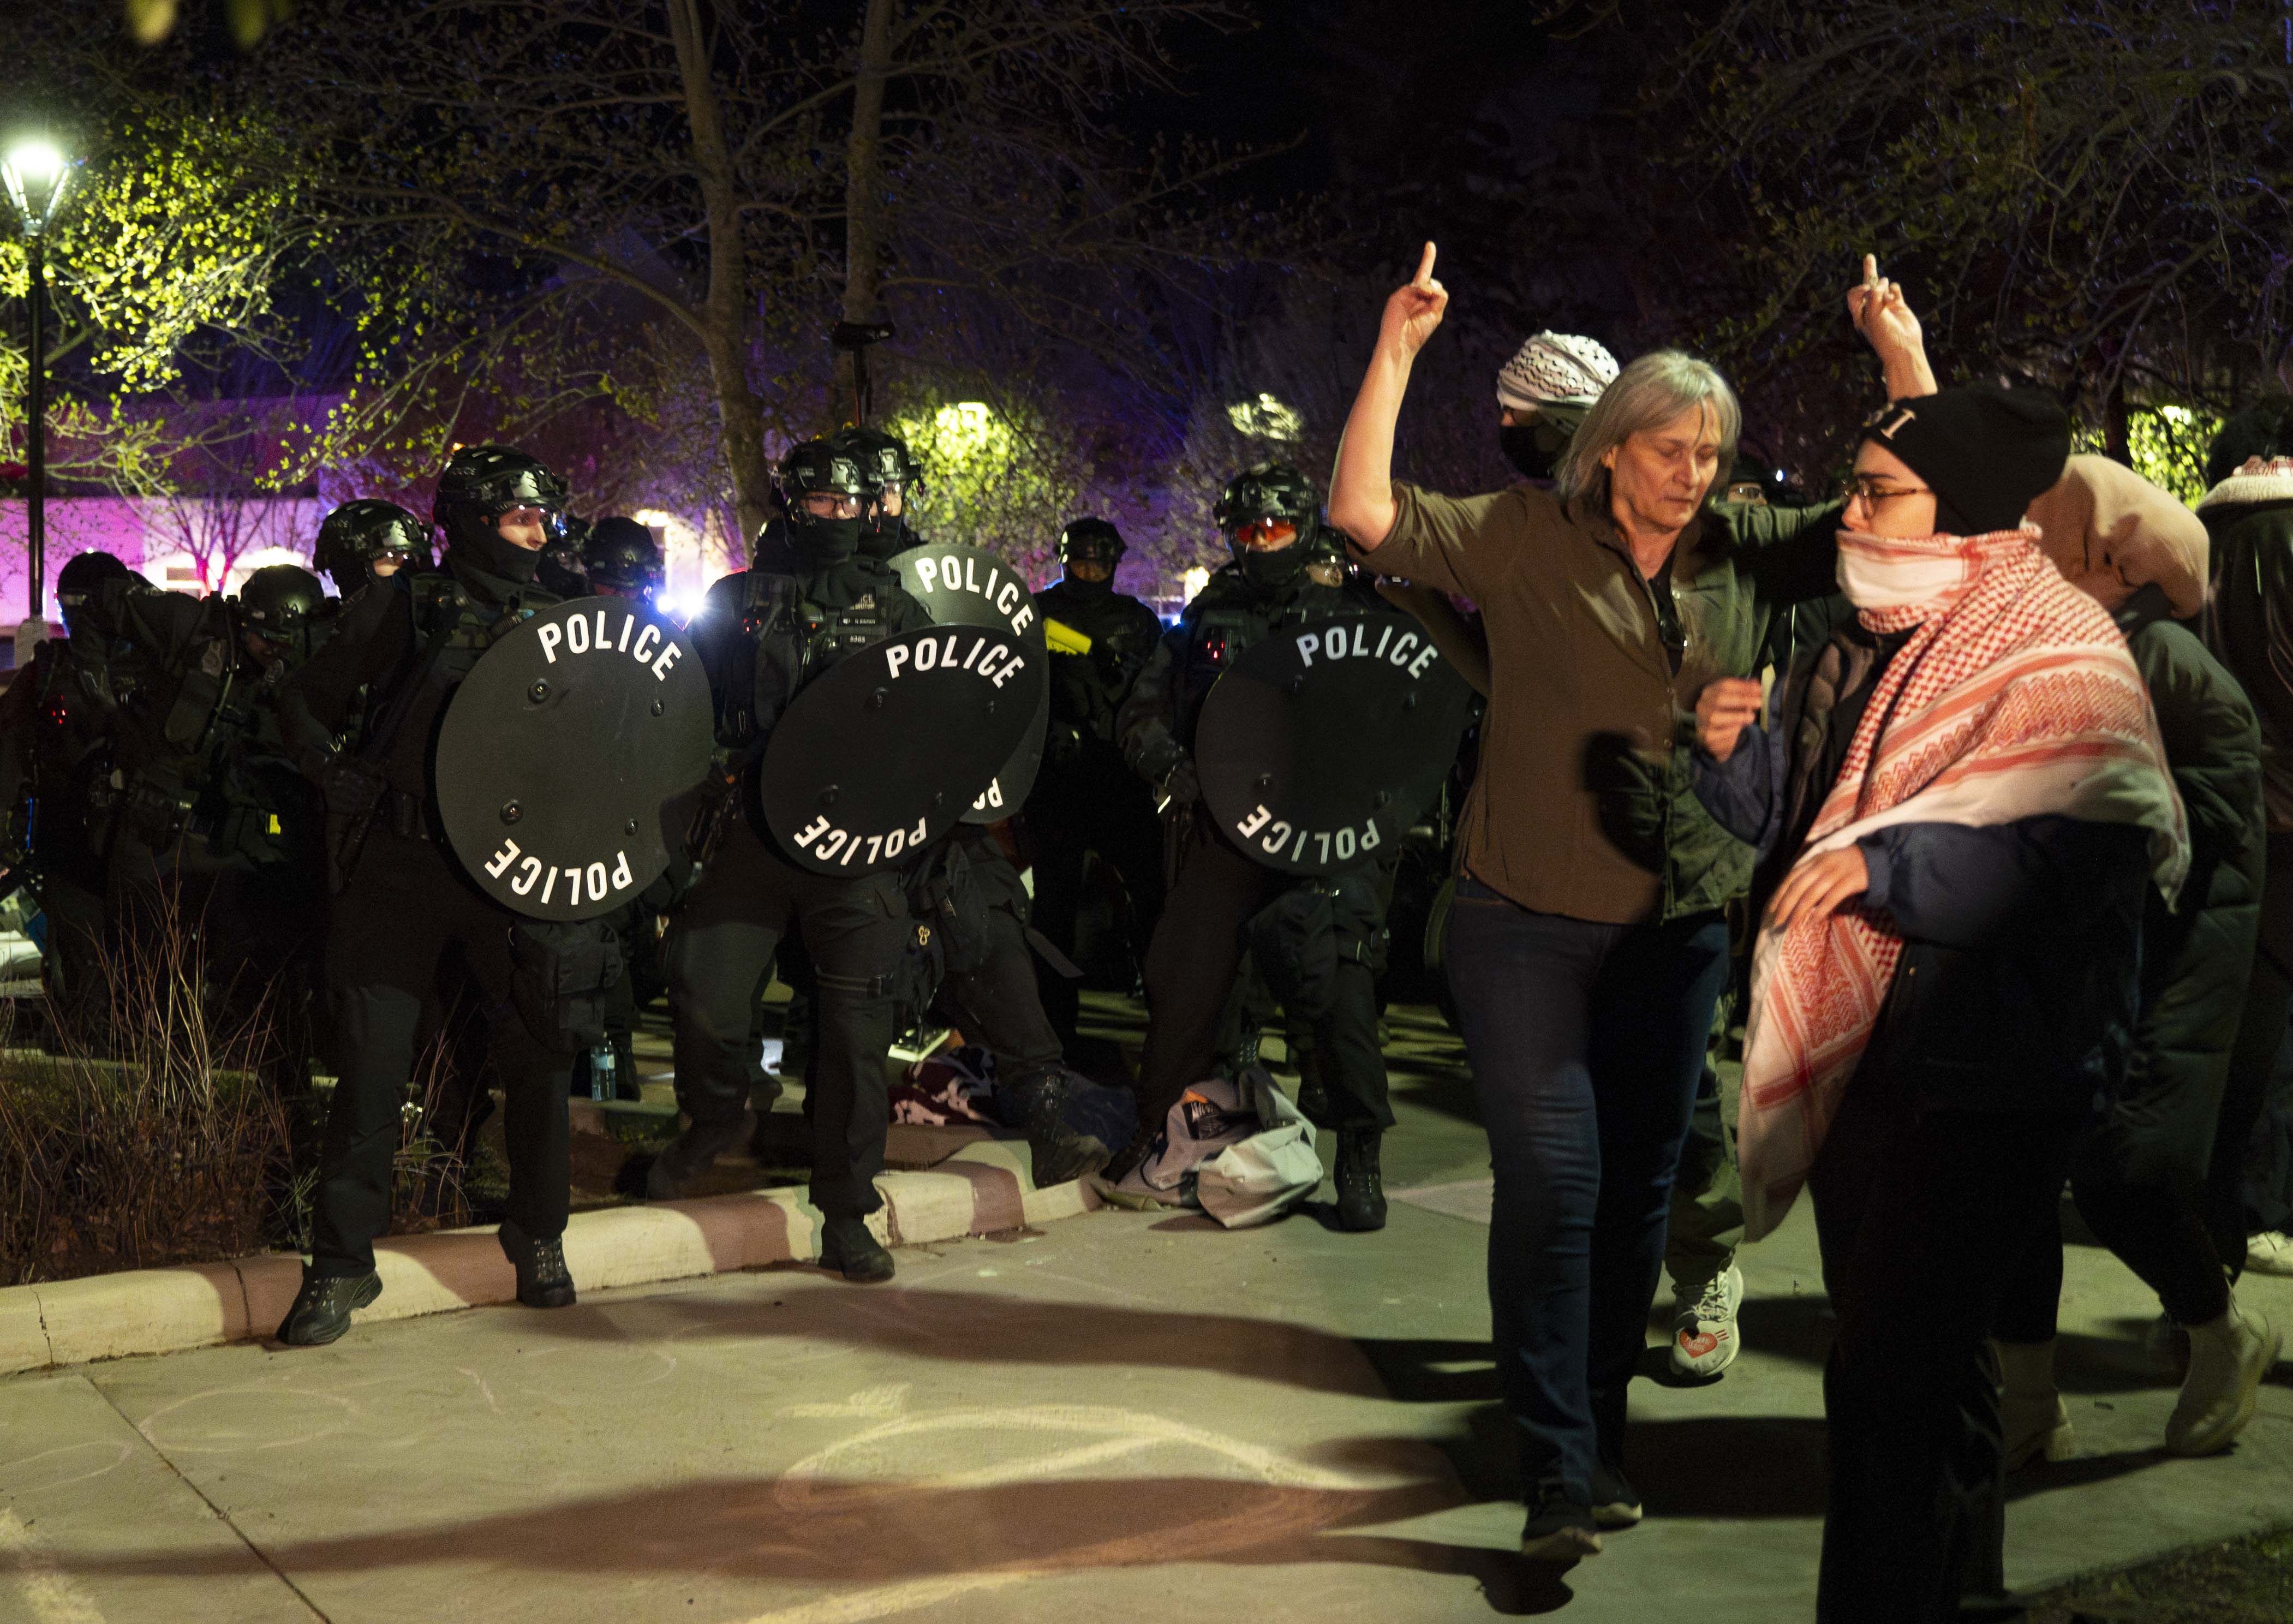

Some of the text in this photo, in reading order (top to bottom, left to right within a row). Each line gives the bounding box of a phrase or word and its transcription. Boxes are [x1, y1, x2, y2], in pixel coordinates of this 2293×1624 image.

[913, 554, 1034, 637] POLICE
[536, 610, 683, 682] POLICE
[885, 635, 1025, 689] POLICE
[1295, 623, 1438, 680] POLICE
[793, 814, 927, 867] POLICE
[1236, 803, 1381, 864] POLICE
[483, 838, 634, 906] POLICE
